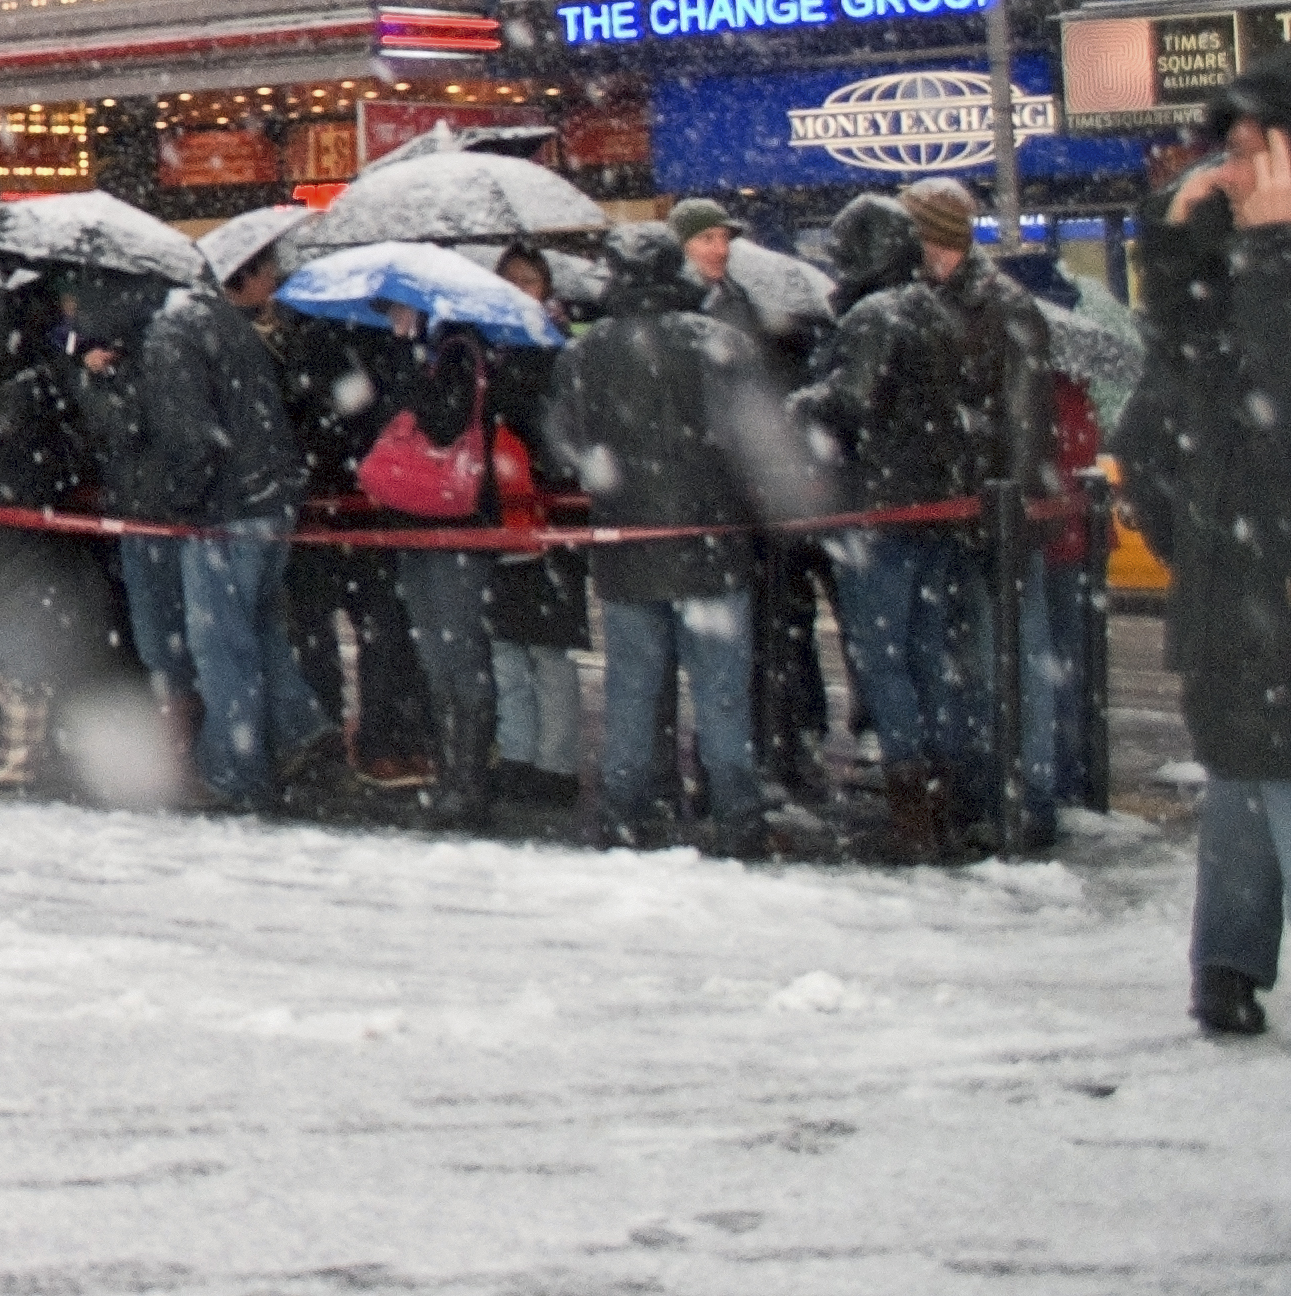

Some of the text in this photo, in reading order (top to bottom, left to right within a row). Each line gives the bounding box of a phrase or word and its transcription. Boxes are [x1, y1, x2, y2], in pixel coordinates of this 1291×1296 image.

[558, 0, 639, 45] THE
[1164, 31, 1220, 51] TIMES
[1157, 51, 1227, 74] SQUARE
[1163, 72, 1229, 89] ALLIANCE
[790, 111, 899, 140] MONEY
